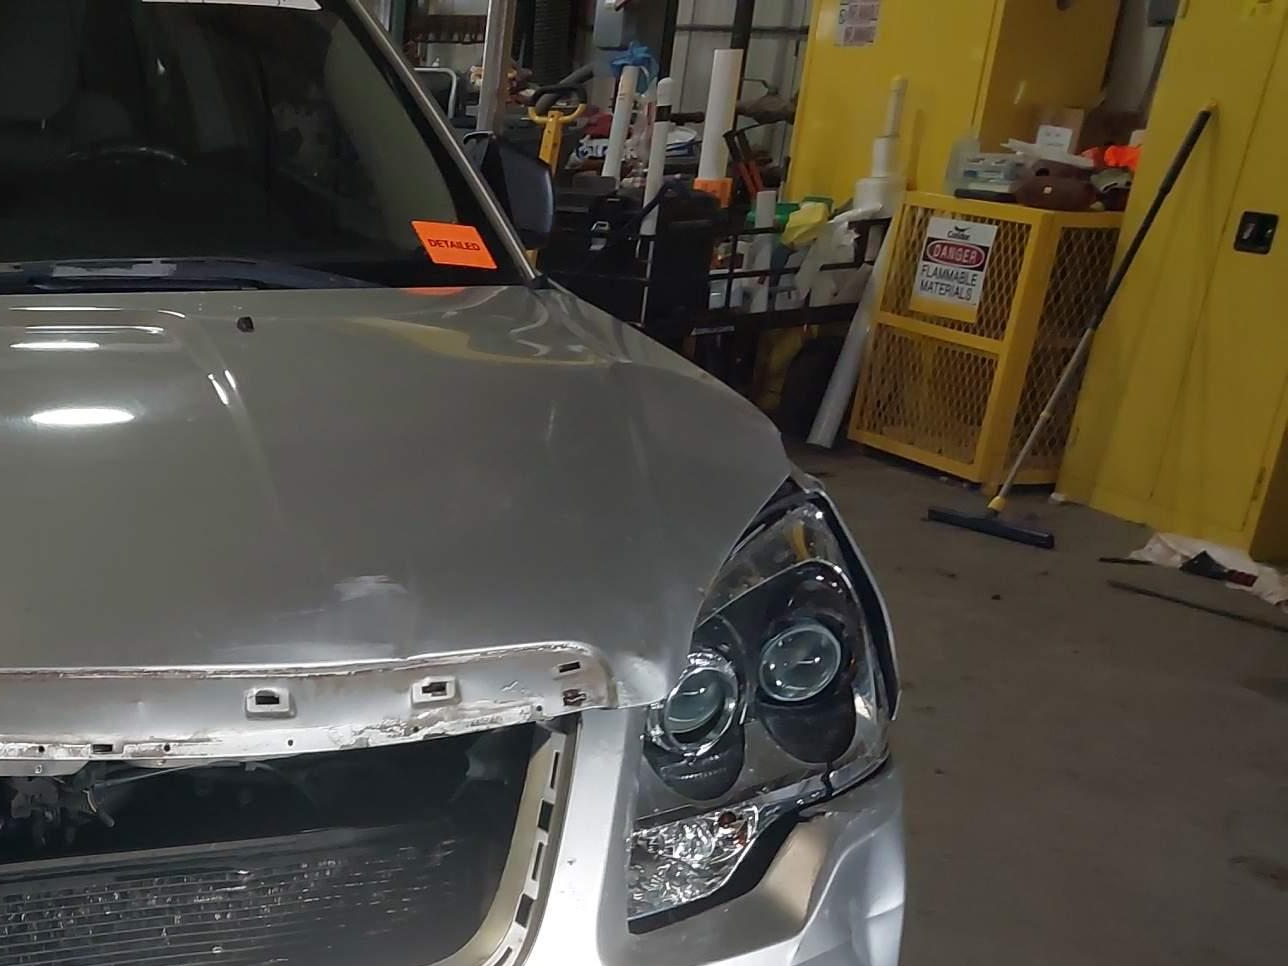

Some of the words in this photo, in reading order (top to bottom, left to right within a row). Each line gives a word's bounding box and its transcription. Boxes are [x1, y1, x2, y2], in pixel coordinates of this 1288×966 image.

[427, 239, 481, 251] DETAILED
[933, 244, 978, 264] DANGER
[922, 264, 979, 287] FLAMMABLE
[920, 280, 972, 301] MATERIALS
